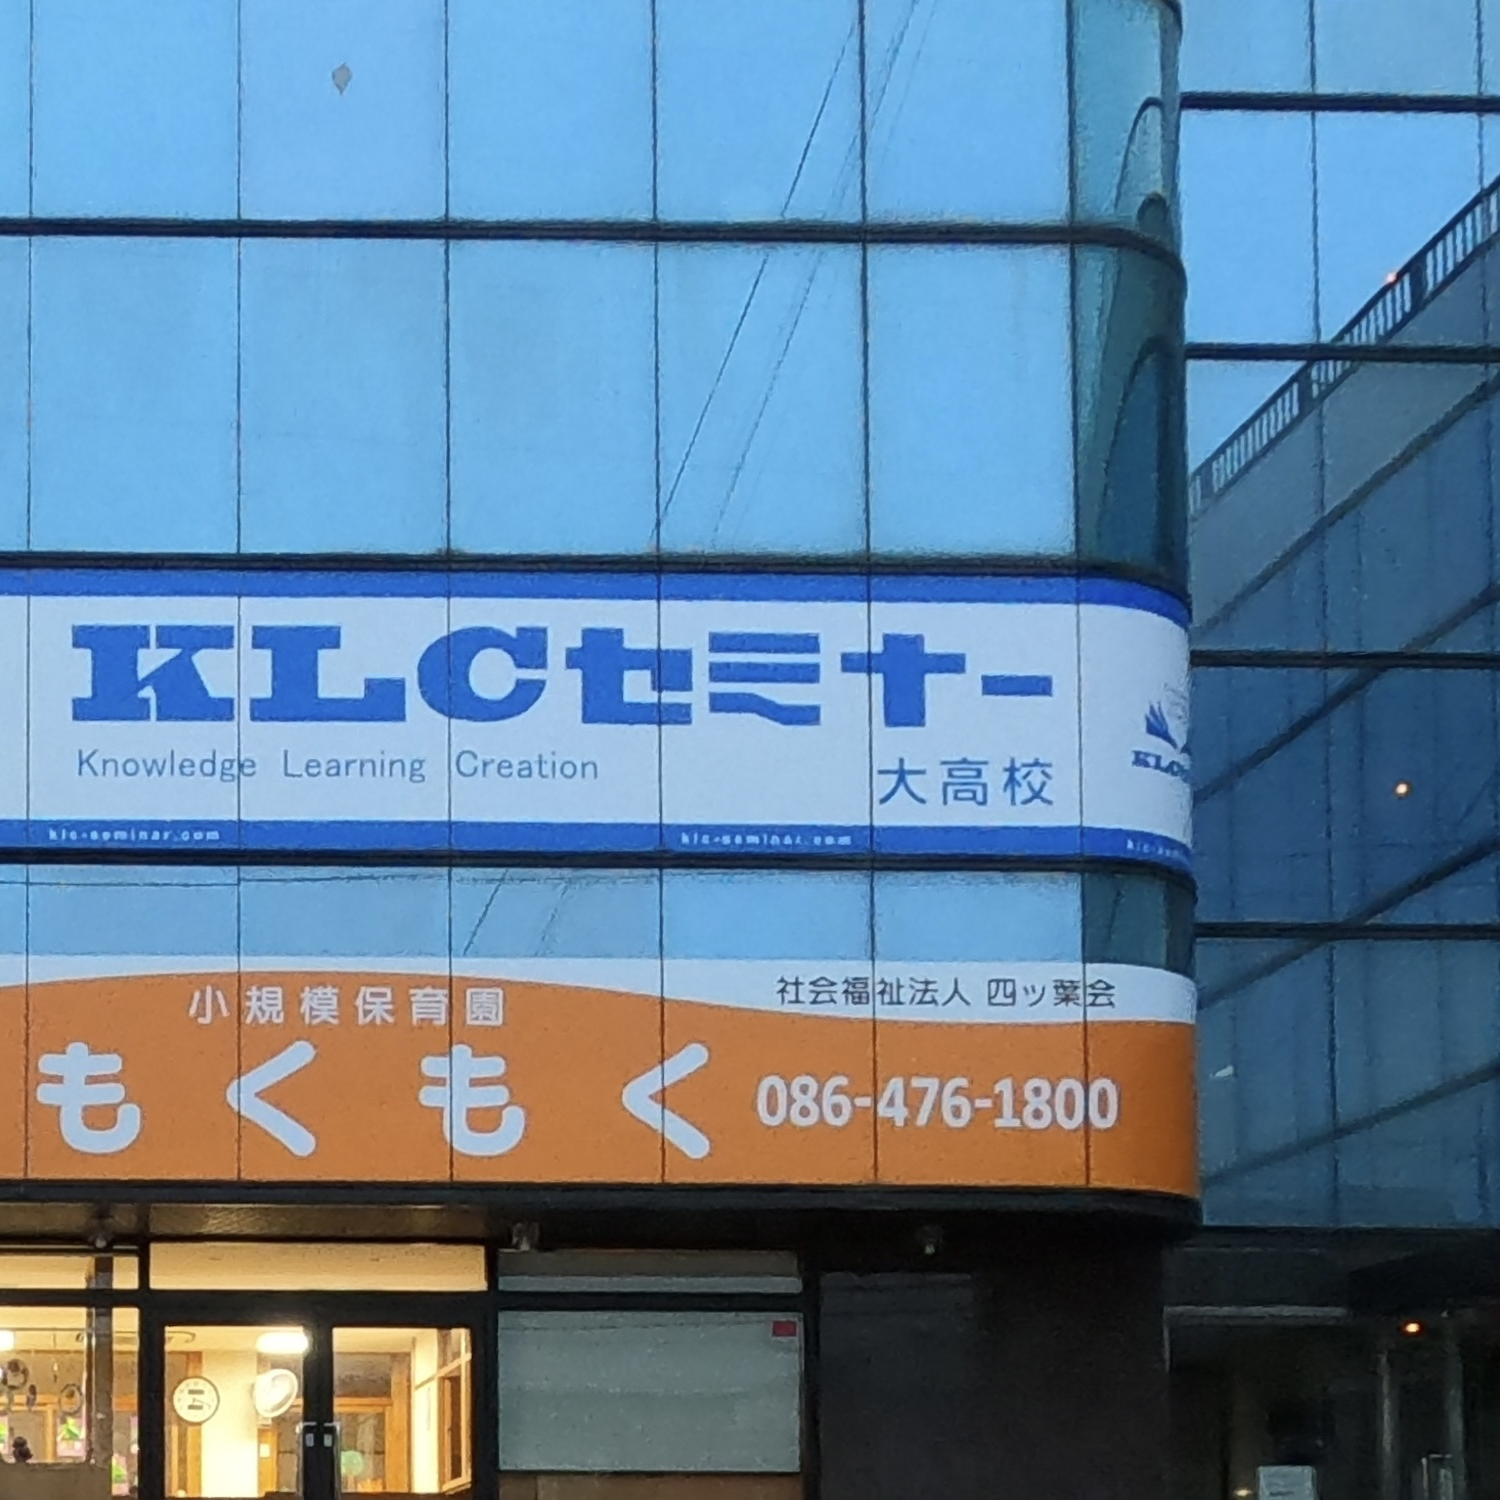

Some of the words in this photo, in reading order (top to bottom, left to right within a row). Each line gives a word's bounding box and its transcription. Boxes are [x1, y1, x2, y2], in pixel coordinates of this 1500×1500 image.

[73, 624, 1053, 728] KLCセミナー
[78, 749, 257, 783] Knowledge
[284, 750, 426, 783] Learning
[455, 750, 599, 780] Creation
[877, 757, 1055, 807] 大高校
[49, 828, 221, 842] klc-seminar.com
[188, 985, 504, 1026] 小規模保育園
[777, 976, 972, 1007] 社会福祉法人
[987, 978, 1116, 1008] 四ツ葉会
[35, 1039, 711, 1160] もくもく
[756, 1074, 1120, 1131] 086-476-1800
